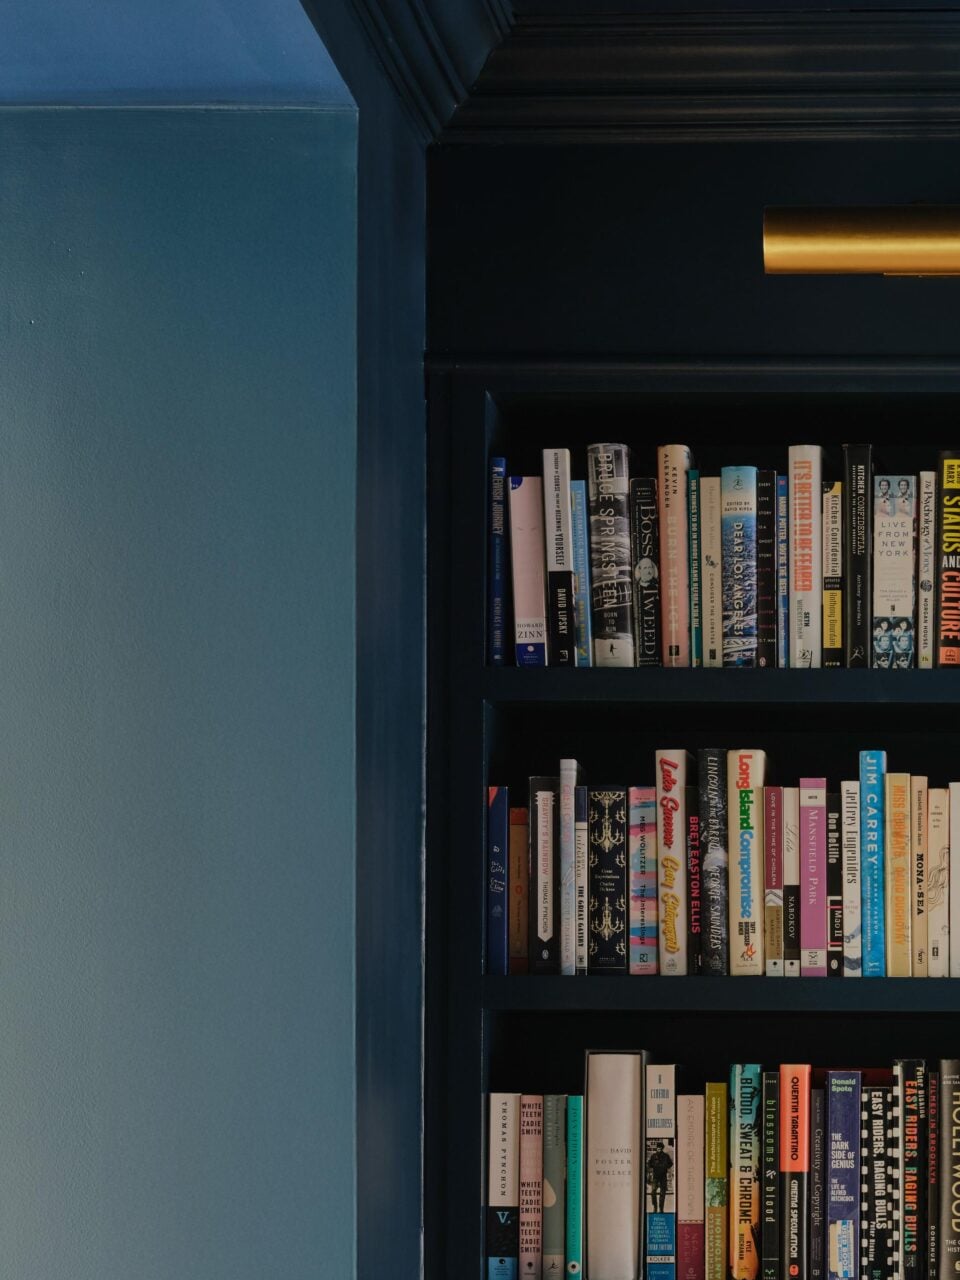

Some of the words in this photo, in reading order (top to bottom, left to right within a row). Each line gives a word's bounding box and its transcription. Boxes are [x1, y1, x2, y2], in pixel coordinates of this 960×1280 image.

[597, 452, 614, 502] BRUCE
[663, 453, 671, 509] ALEXANDER
[857, 464, 866, 494] KITCHEN
[946, 464, 955, 484] MARX
[830, 494, 841, 524] Kitchen
[640, 505, 657, 557] BOSS
[733, 522, 743, 552] DEAR
[857, 495, 866, 555] CONFIDENTIAL
[598, 508, 617, 607] SPRINGSTEEN
[830, 527, 841, 576] Confidential
[733, 557, 743, 580] LOS
[557, 588, 567, 608] DAVID
[733, 584, 744, 636] ANGELES
[941, 570, 960, 640] CULTURE
[558, 610, 568, 634] LIPSKY
[643, 585, 659, 655] TWEED
[803, 611, 811, 627] SETH
[518, 631, 543, 639] ZINN
[736, 755, 753, 790] Long
[866, 755, 878, 785] JIM
[739, 789, 754, 830] Island
[828, 812, 839, 829] Don
[844, 789, 859, 827] Jeffrey
[690, 816, 700, 845] BRET
[808, 810, 819, 872] MANSFIELD
[866, 793, 879, 866] CARREY
[828, 832, 839, 864] DeLillo
[844, 831, 859, 884] Eugenides
[689, 850, 700, 898] EASTON
[738, 831, 754, 919] Compromise
[916, 853, 925, 884] MONA
[577, 885, 585, 898] THE
[808, 877, 819, 905] PARK
[916, 891, 925, 916] SEA
[577, 899, 585, 921] GREAT
[690, 901, 700, 934] ELLIS
[834, 910, 842, 928] Mao
[577, 923, 585, 948] GATSBY
[738, 1078, 753, 1119] BLOOD,
[790, 1076, 799, 1113] QUENTIN
[739, 1122, 753, 1161] SWEAT
[790, 1115, 799, 1161] TARANTINO
[831, 1133, 842, 1141] THE
[831, 1142, 849, 1150] DARK
[831, 1151, 846, 1160] SIDE
[847, 1151, 855, 1159] OF
[831, 1160, 855, 1169] GENIUS
[739, 1177, 753, 1224] CHROME
[790, 1179, 799, 1208] CINEMA
[496, 1211, 511, 1224] V.
[789, 1209, 799, 1258] SPECULATION
[945, 1239, 956, 1247] THE
